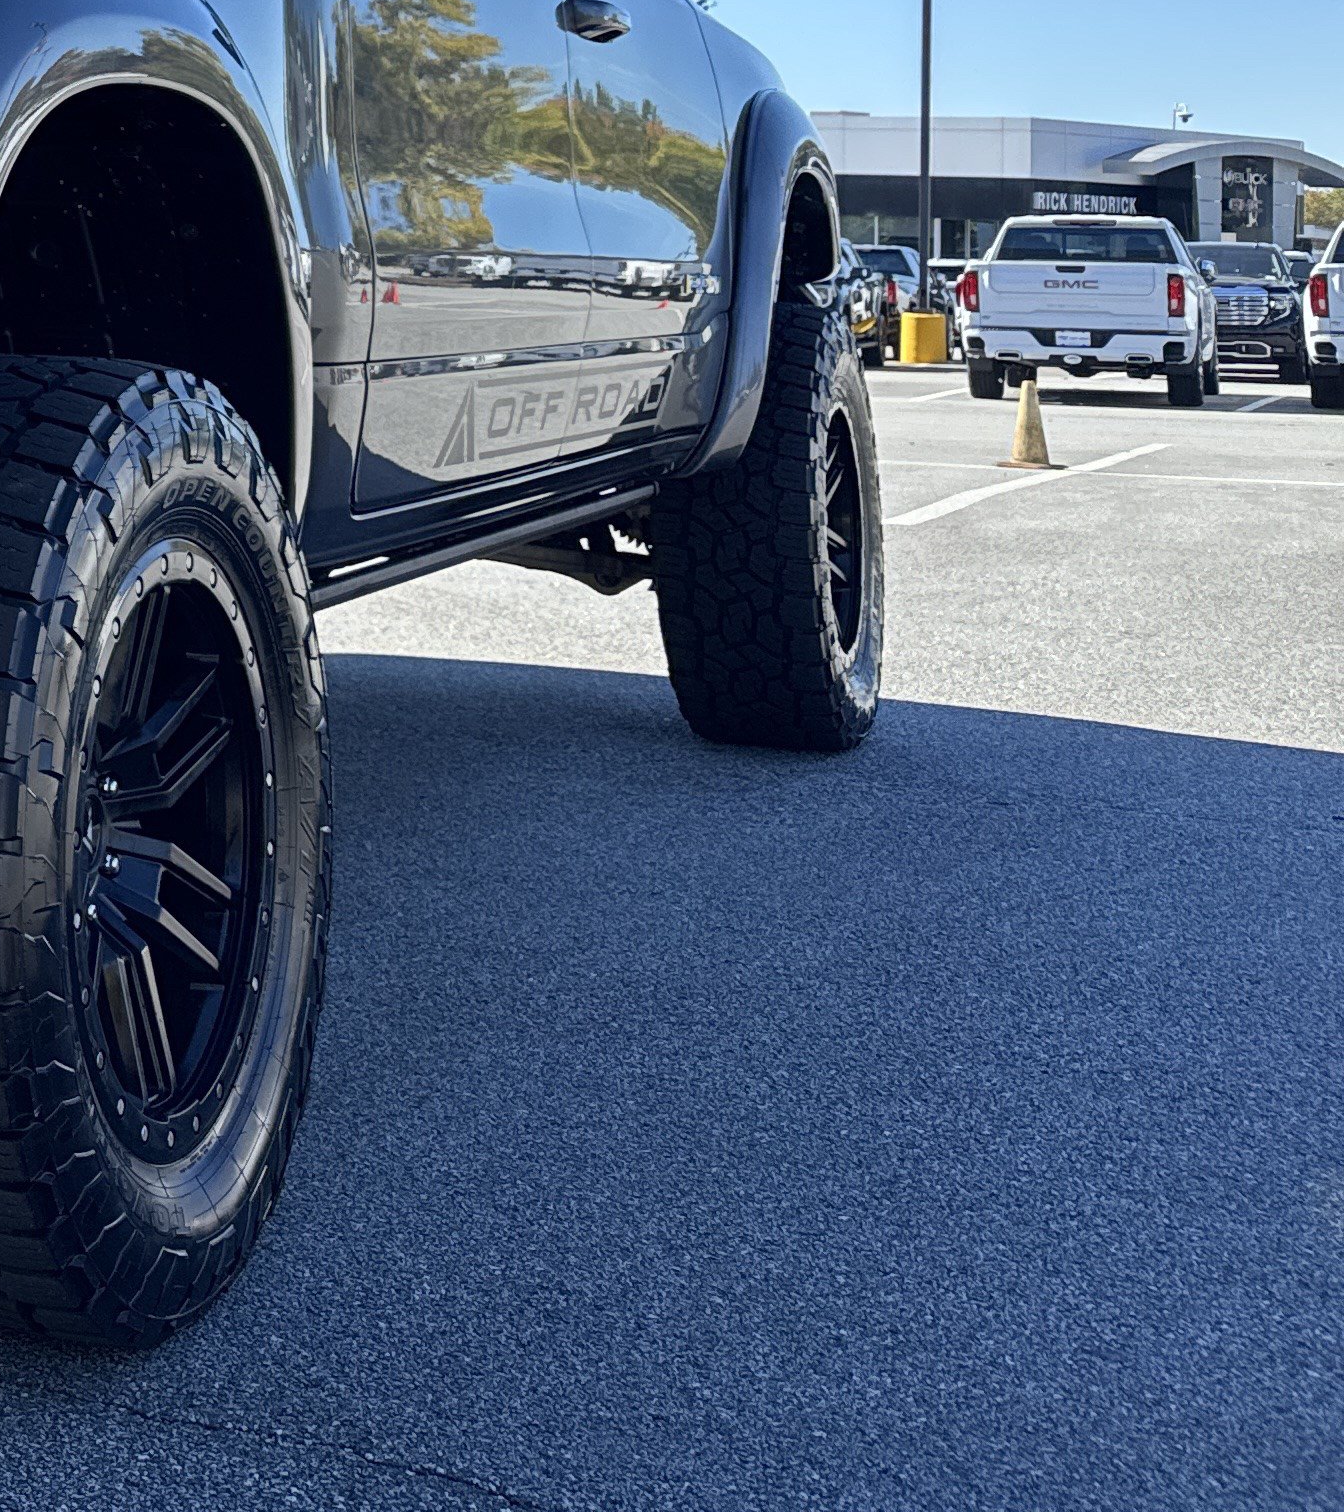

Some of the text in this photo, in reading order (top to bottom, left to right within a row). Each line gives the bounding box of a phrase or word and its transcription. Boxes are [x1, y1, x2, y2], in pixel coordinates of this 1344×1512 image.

[1033, 191, 1138, 215] RICK HENDRICK
[1043, 279, 1100, 290] GMC
[487, 377, 666, 439] OFF ROAD
[162, 477, 235, 512] OPEN
